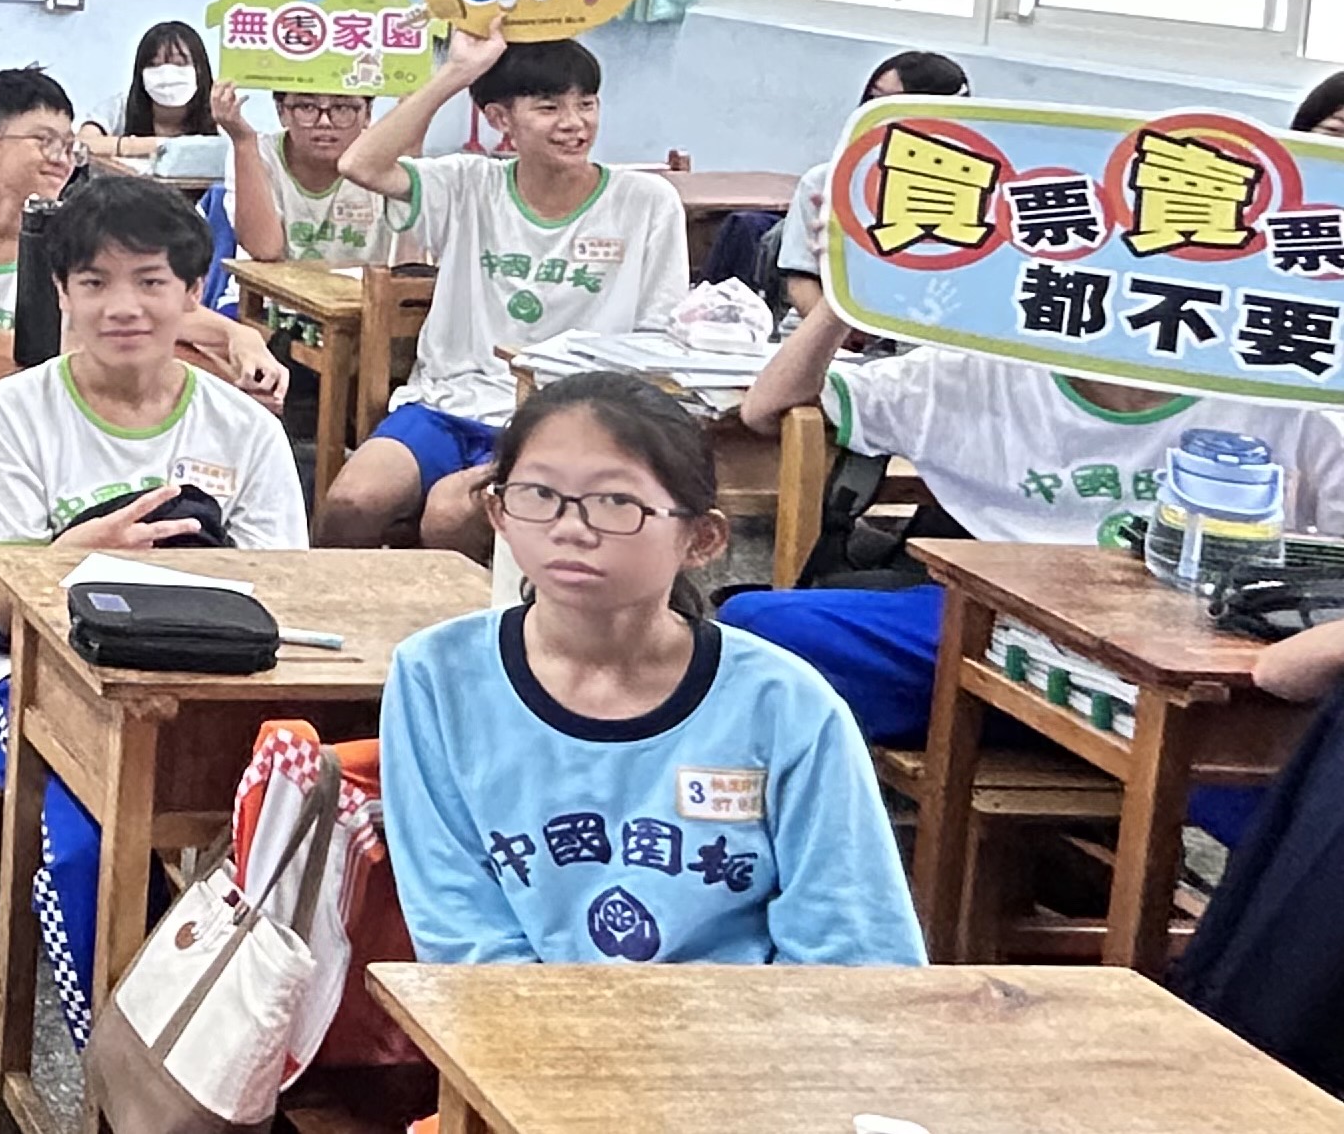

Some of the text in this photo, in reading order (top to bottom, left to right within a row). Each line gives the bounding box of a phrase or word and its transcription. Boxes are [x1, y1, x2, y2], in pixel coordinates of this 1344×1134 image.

[227, 7, 429, 53] 無毒家園
[867, 123, 1344, 274] 買票賣票
[1020, 264, 1342, 377] 都不要
[174, 463, 185, 479] 3
[688, 780, 706, 804] 3
